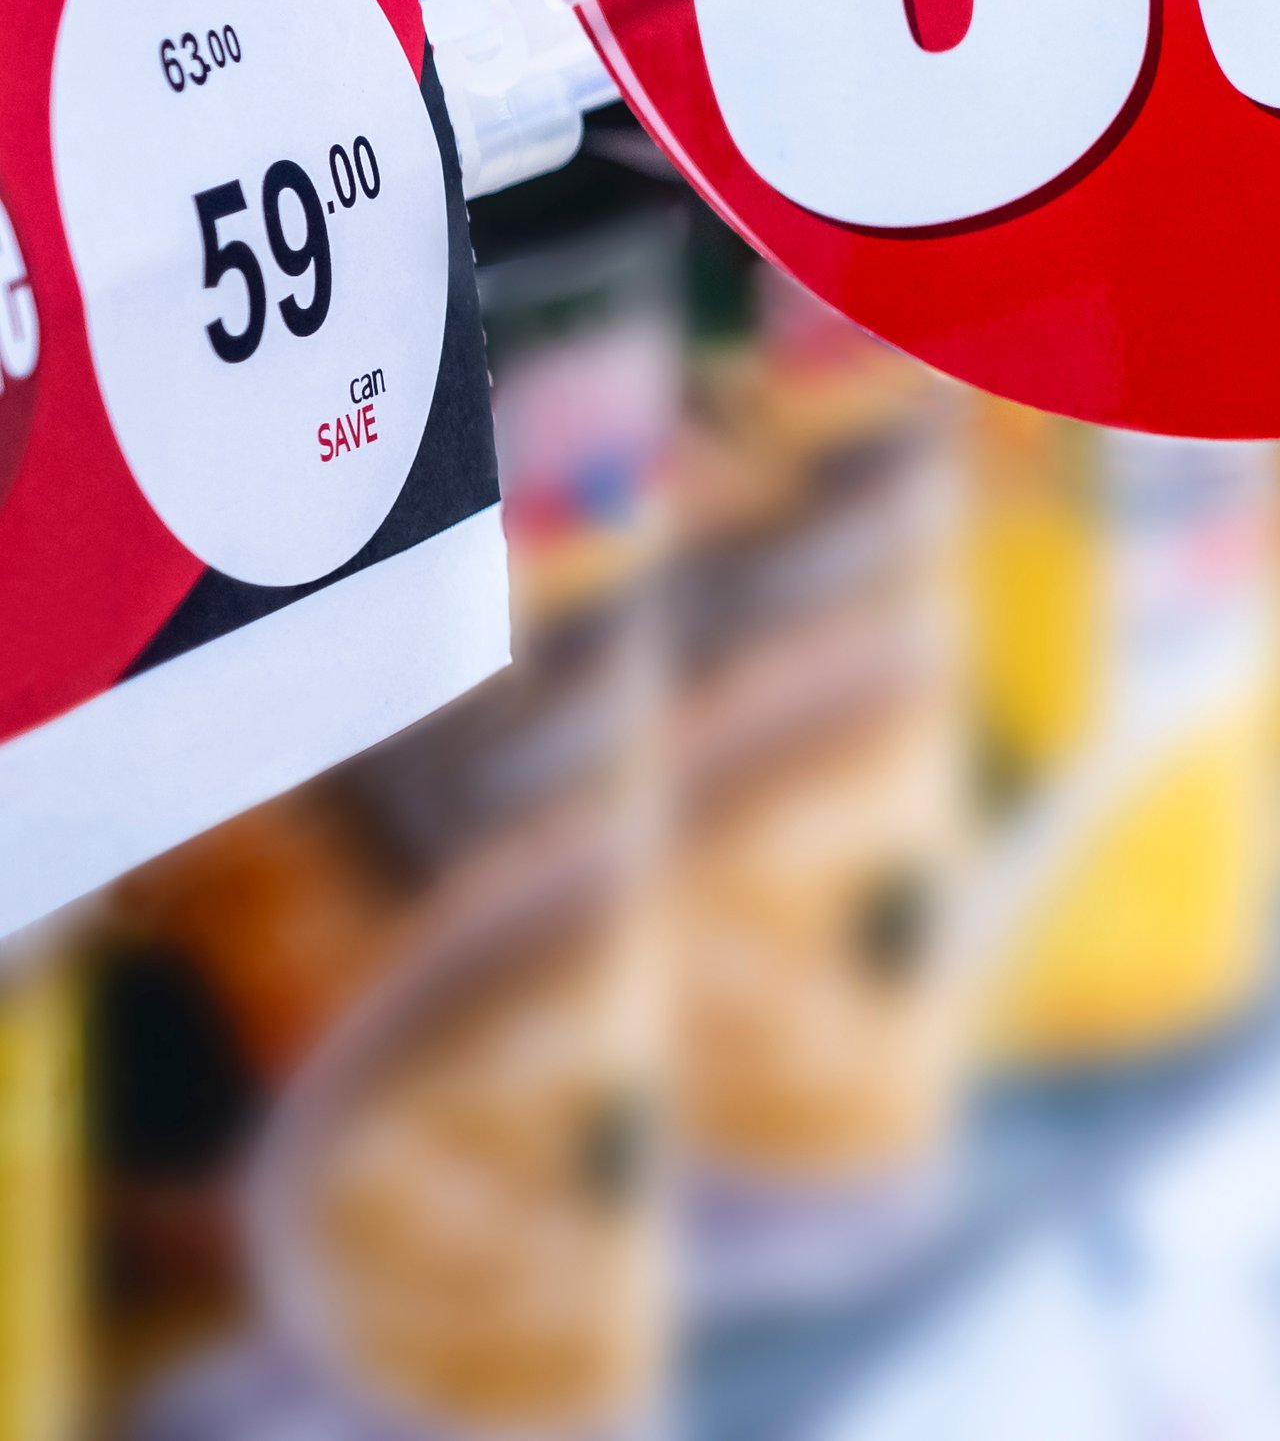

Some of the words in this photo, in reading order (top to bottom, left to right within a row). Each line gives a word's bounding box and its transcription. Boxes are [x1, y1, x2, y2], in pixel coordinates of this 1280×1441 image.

[160, 25, 241, 93] 63.00
[193, 135, 381, 364] 59.00
[350, 368, 386, 404] can
[318, 404, 378, 462] SAVE
